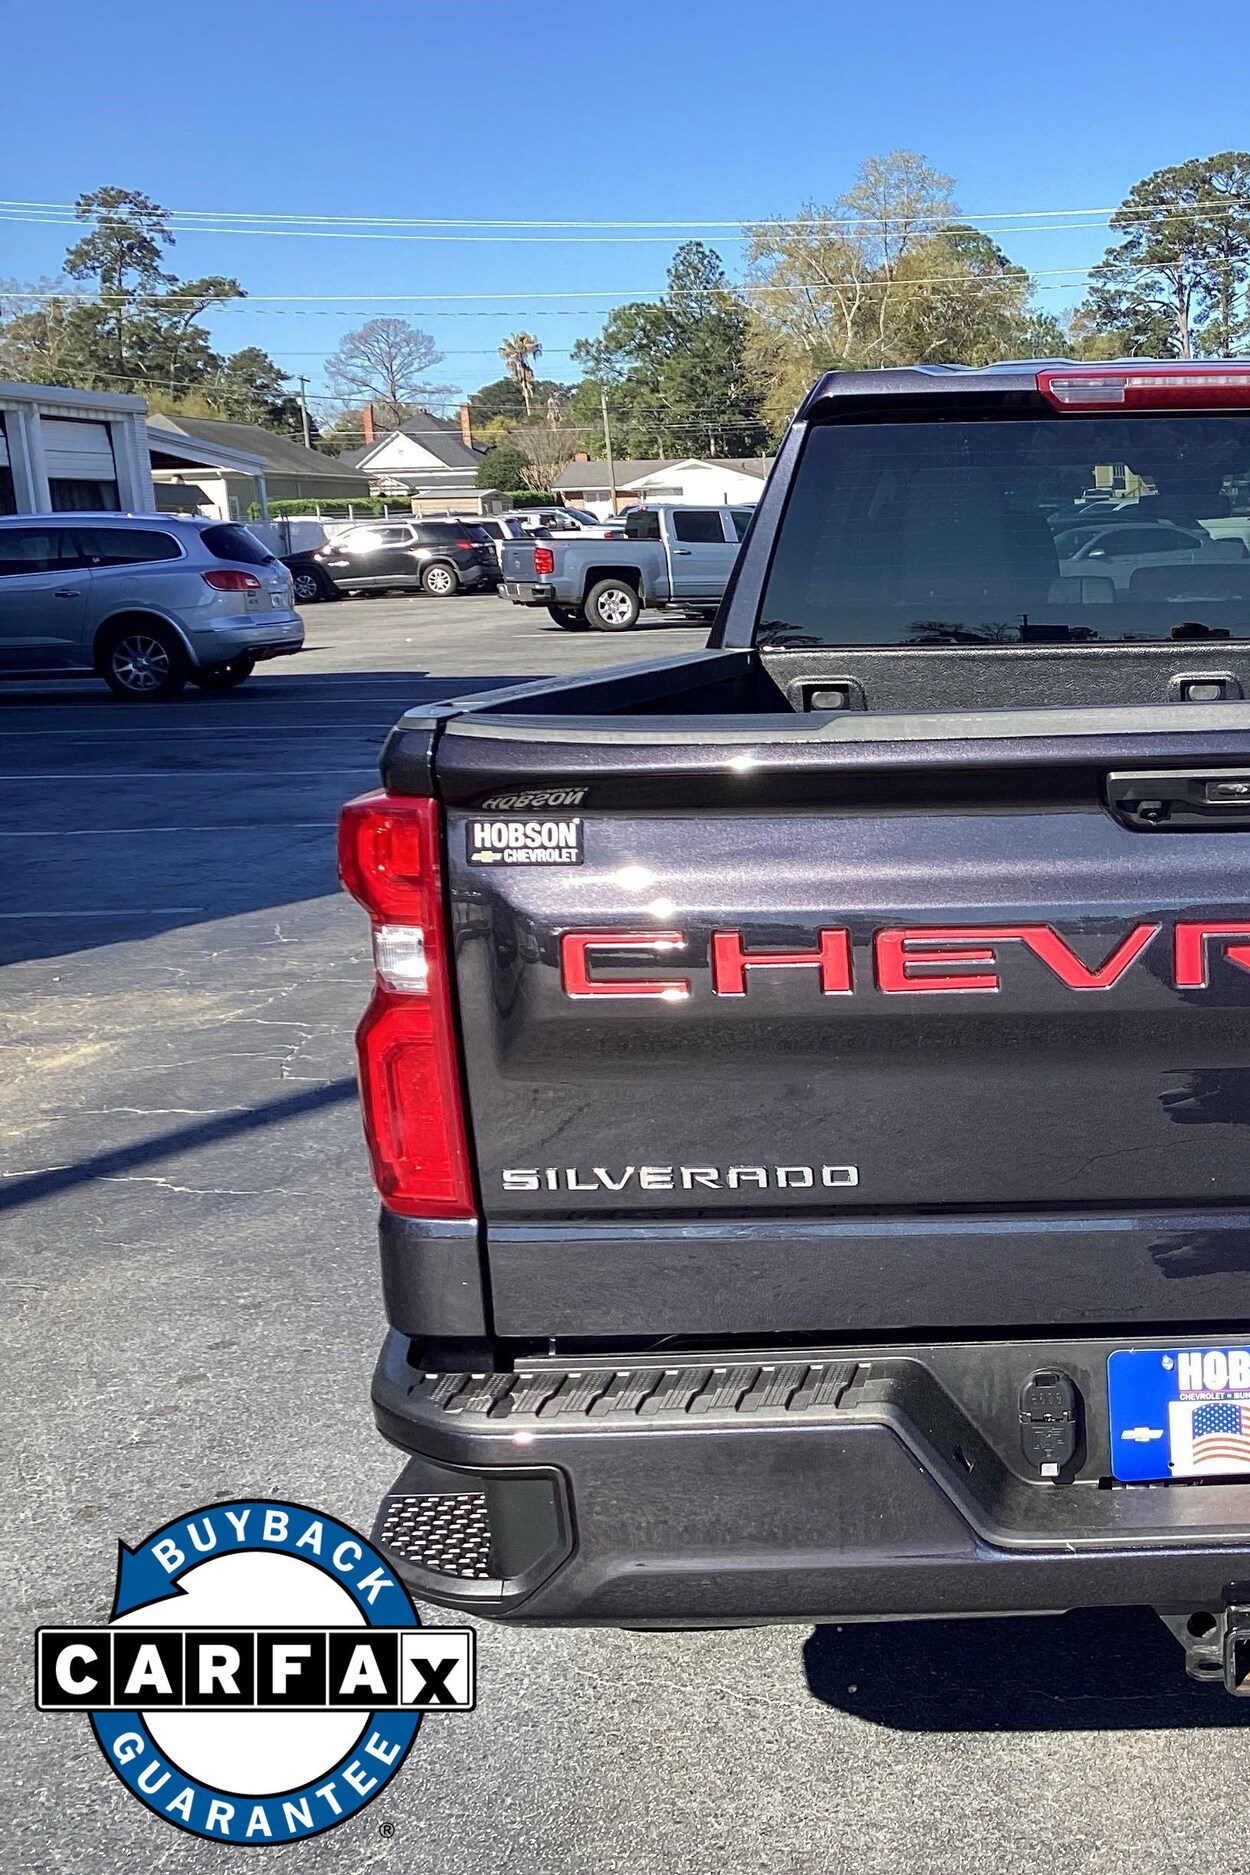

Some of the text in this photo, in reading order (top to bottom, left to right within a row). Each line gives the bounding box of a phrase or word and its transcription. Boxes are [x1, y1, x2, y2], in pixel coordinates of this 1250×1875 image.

[473, 822, 577, 848] HOBSON
[503, 848, 579, 863] CHEVROLET
[501, 1165, 860, 1191] SILVERADO
[1179, 1391, 1226, 1401] CHEVROLET
